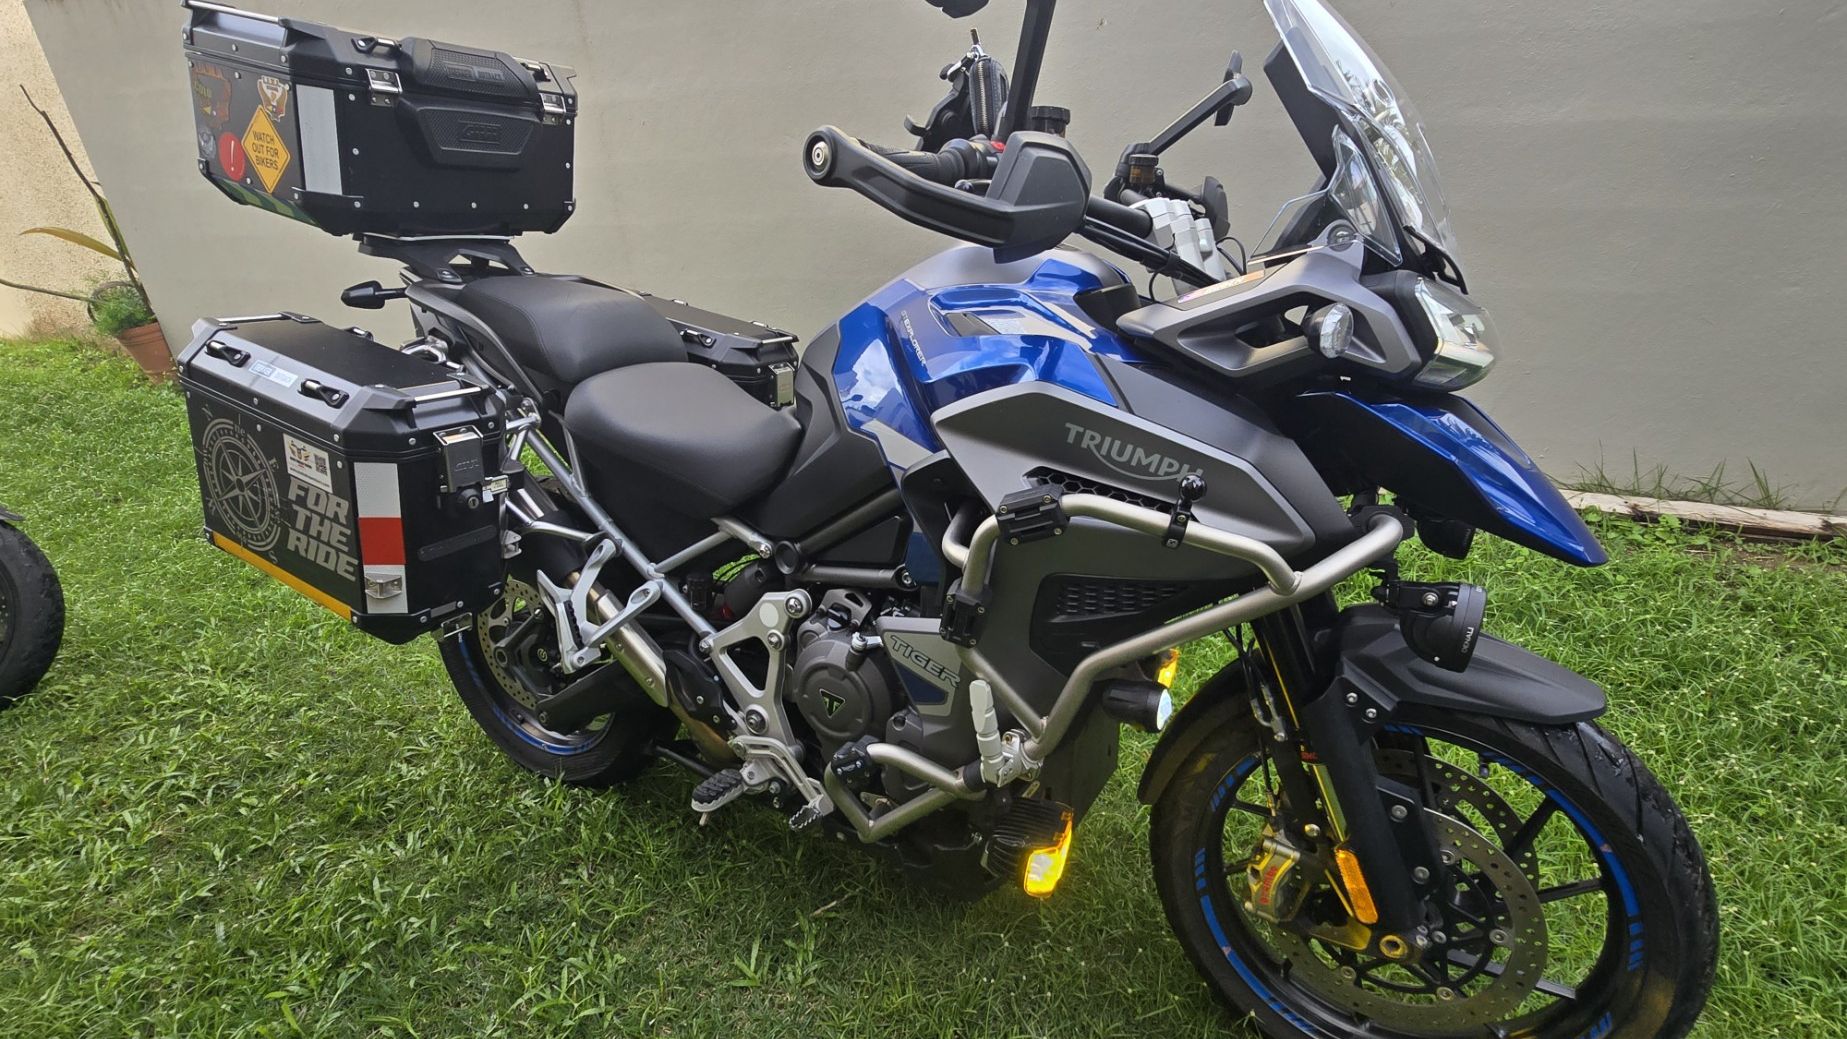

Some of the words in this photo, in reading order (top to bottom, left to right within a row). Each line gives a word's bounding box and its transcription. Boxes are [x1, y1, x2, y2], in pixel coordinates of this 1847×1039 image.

[252, 142, 265, 155] OUT
[266, 145, 279, 159] FOR
[253, 131, 275, 145] WATCH
[255, 155, 279, 171] BIKERS
[904, 318, 927, 366] EXPLORER
[1065, 422, 1204, 483] TRIUMPH
[288, 476, 349, 525] FOR
[292, 504, 352, 552] THE
[287, 528, 359, 582] RIDE
[890, 634, 961, 688] TIGER
